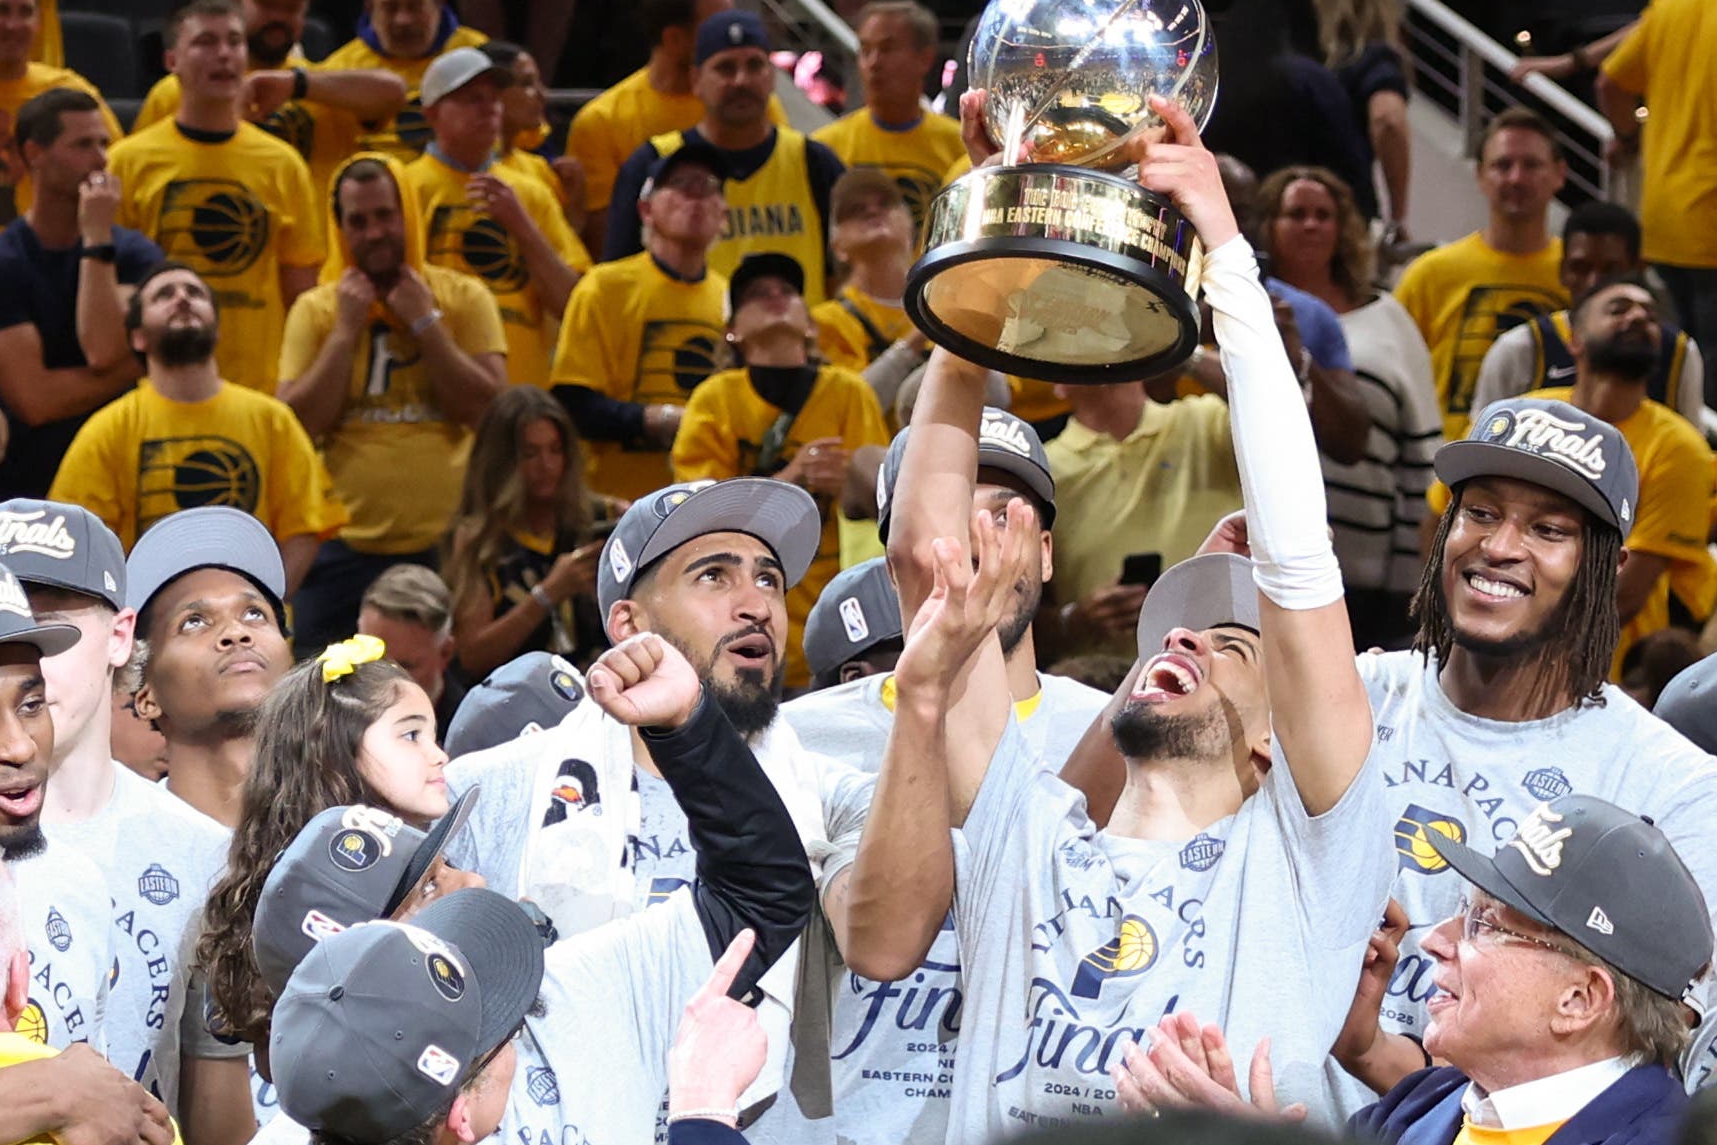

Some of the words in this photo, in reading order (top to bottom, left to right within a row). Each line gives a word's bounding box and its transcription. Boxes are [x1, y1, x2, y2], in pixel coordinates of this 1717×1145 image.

[1006, 206, 1063, 226] EASTERN
[1505, 408, 1606, 473] Finals
[1462, 772, 1518, 842] PAC
[110, 897, 171, 1031] ACERS
[906, 1042, 948, 1053] 2024
[861, 1069, 934, 1083] EASTERN
[1044, 1082, 1081, 1097] 2024
[1072, 1102, 1103, 1116] NBA
